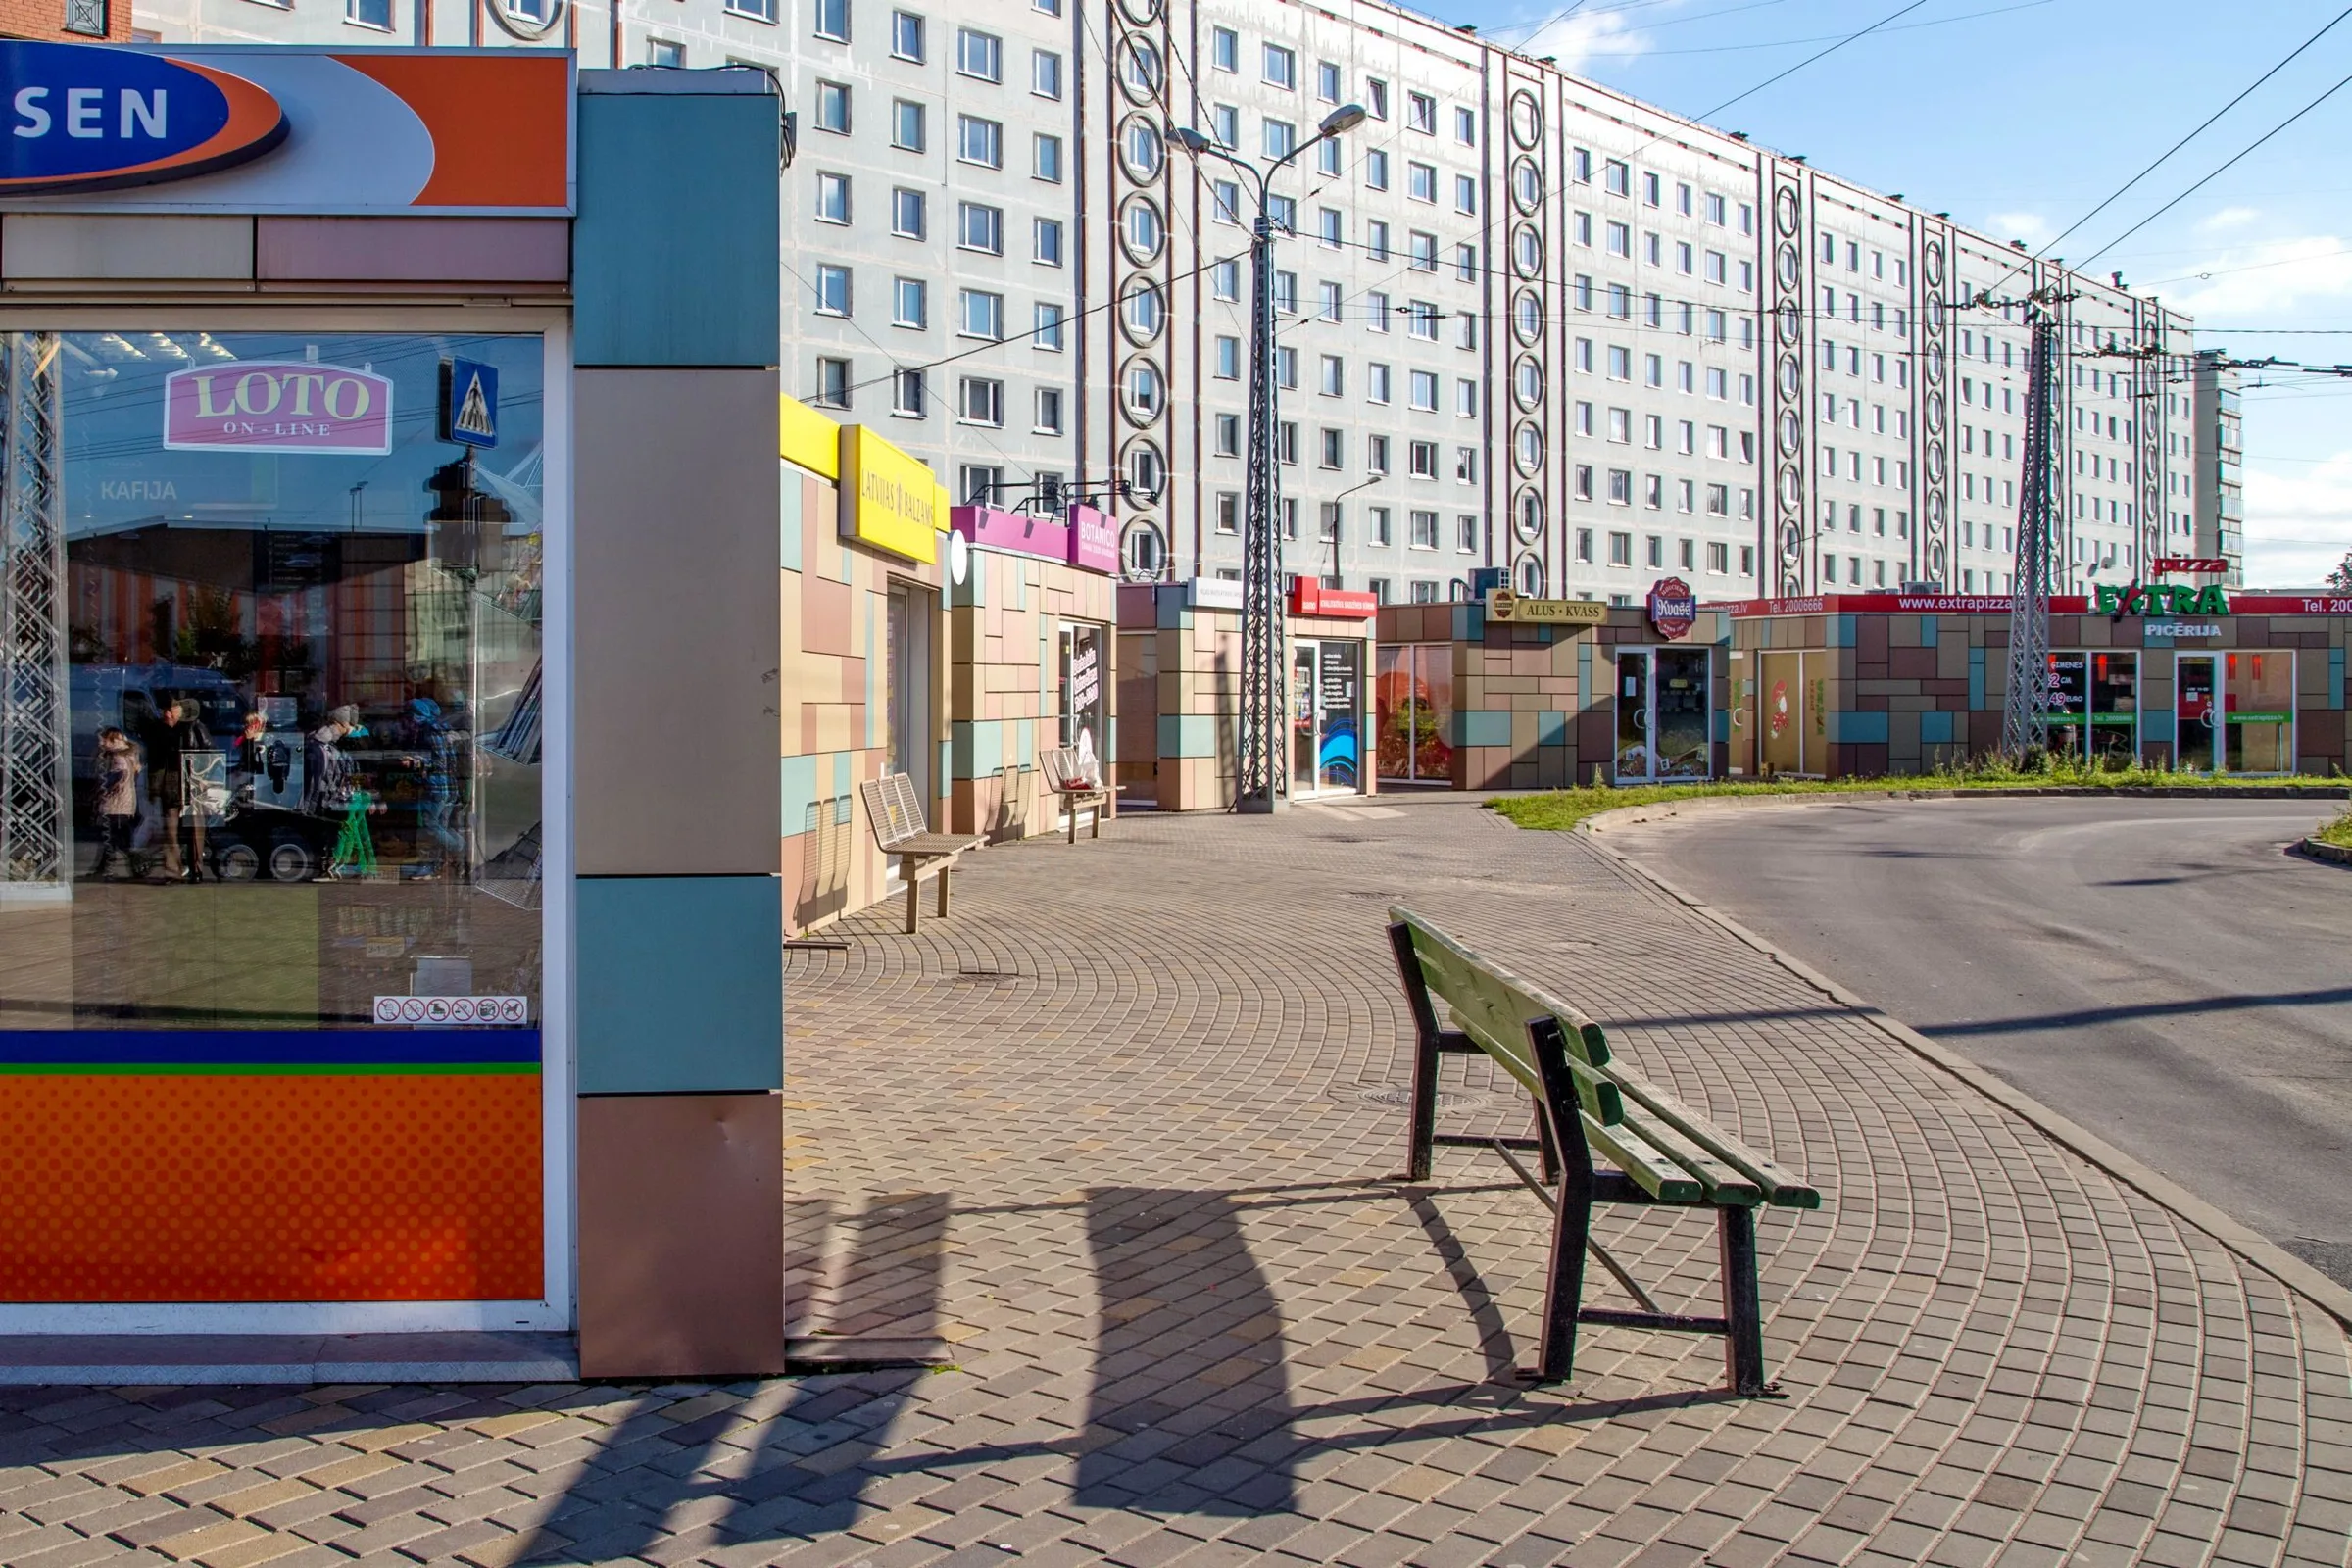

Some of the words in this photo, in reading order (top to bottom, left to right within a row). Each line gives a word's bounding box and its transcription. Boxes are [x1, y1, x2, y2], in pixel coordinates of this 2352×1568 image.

[13, 86, 167, 138] SEN
[192, 372, 370, 420] LOTO
[101, 480, 177, 501] KAFIJA
[862, 468, 895, 511] LATVIJAS
[905, 491, 933, 529] BALZAMS
[1081, 521, 1115, 549] BOTANICO
[2153, 556, 2229, 576] pizza
[1657, 598, 1690, 616] Kvass
[1784, 598, 1823, 612] 20006666
[2095, 579, 2230, 622] EXTRA
[2302, 599, 2326, 612] Tel.
[1527, 605, 1555, 616] ALUS
[1565, 606, 1599, 617] KVASS
[2144, 622, 2222, 637] PICĒRIJA
